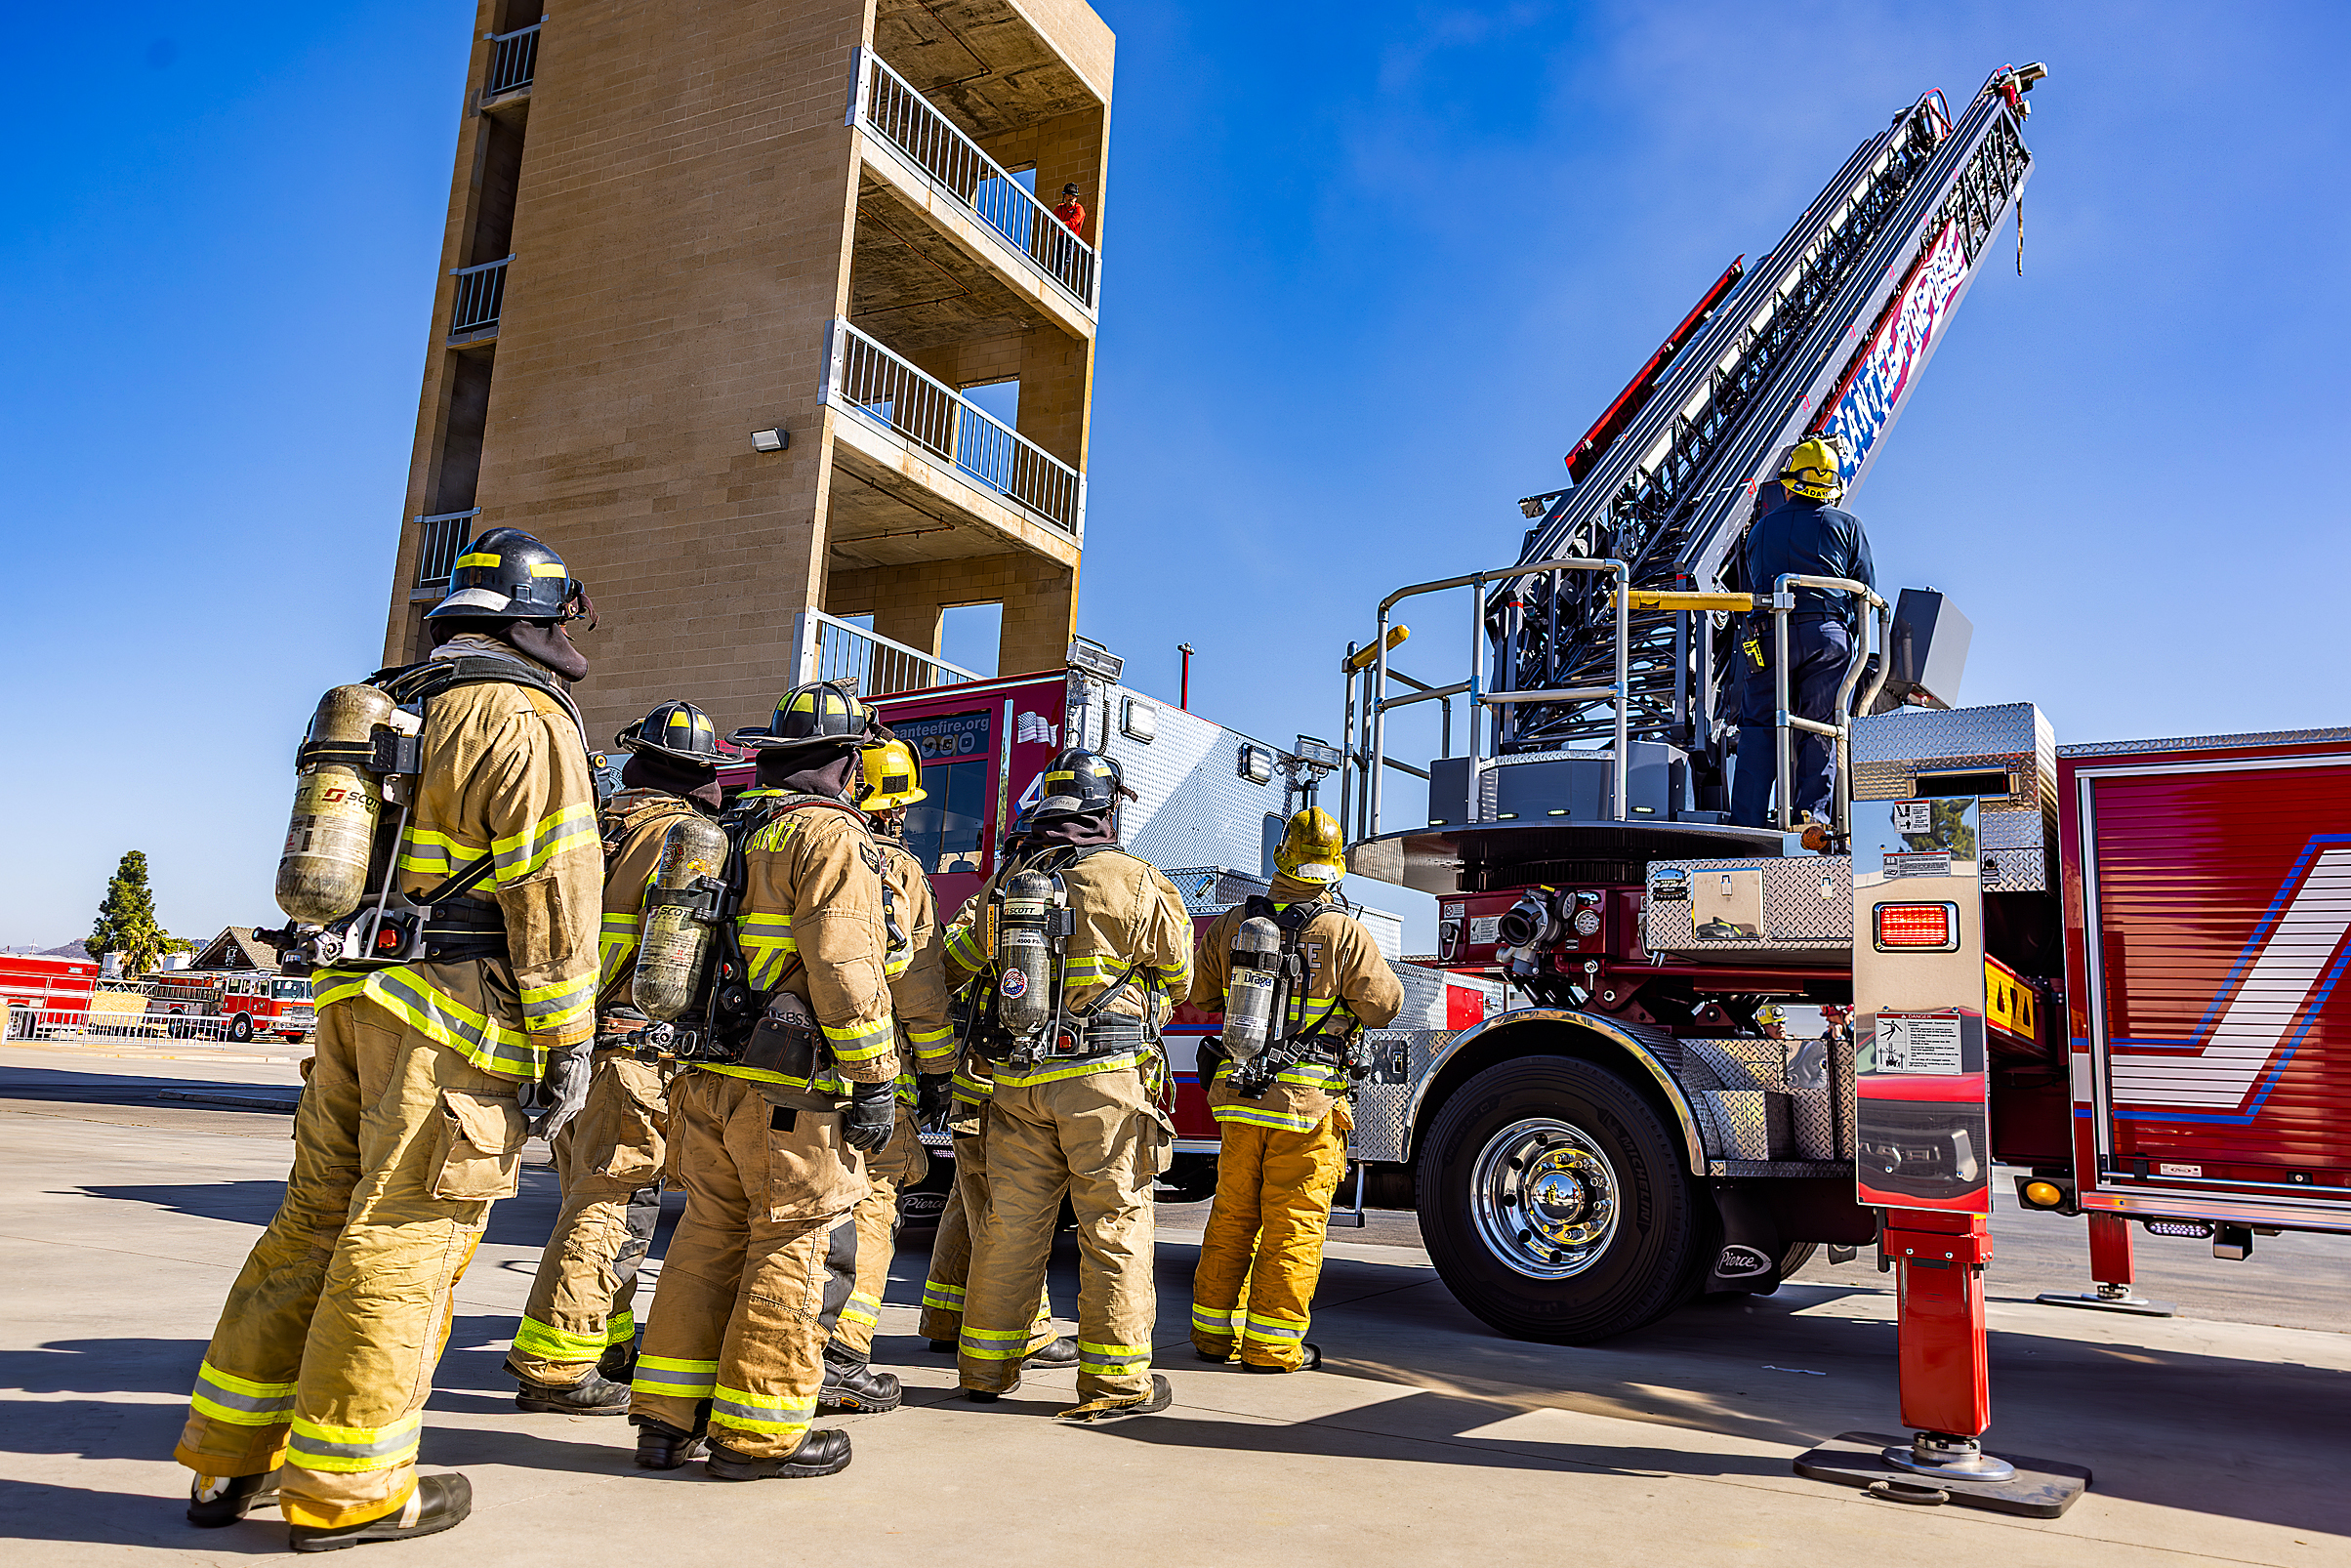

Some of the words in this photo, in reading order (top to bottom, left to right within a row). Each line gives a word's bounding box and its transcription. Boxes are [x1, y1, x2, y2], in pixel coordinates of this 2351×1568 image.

[1894, 286, 1933, 363] FIRE
[660, 906, 693, 918] SCOT
[1621, 1136, 1651, 1220] MICHELIN
[903, 1197, 946, 1211] Pierce
[1718, 1251, 1755, 1270] Pierce
